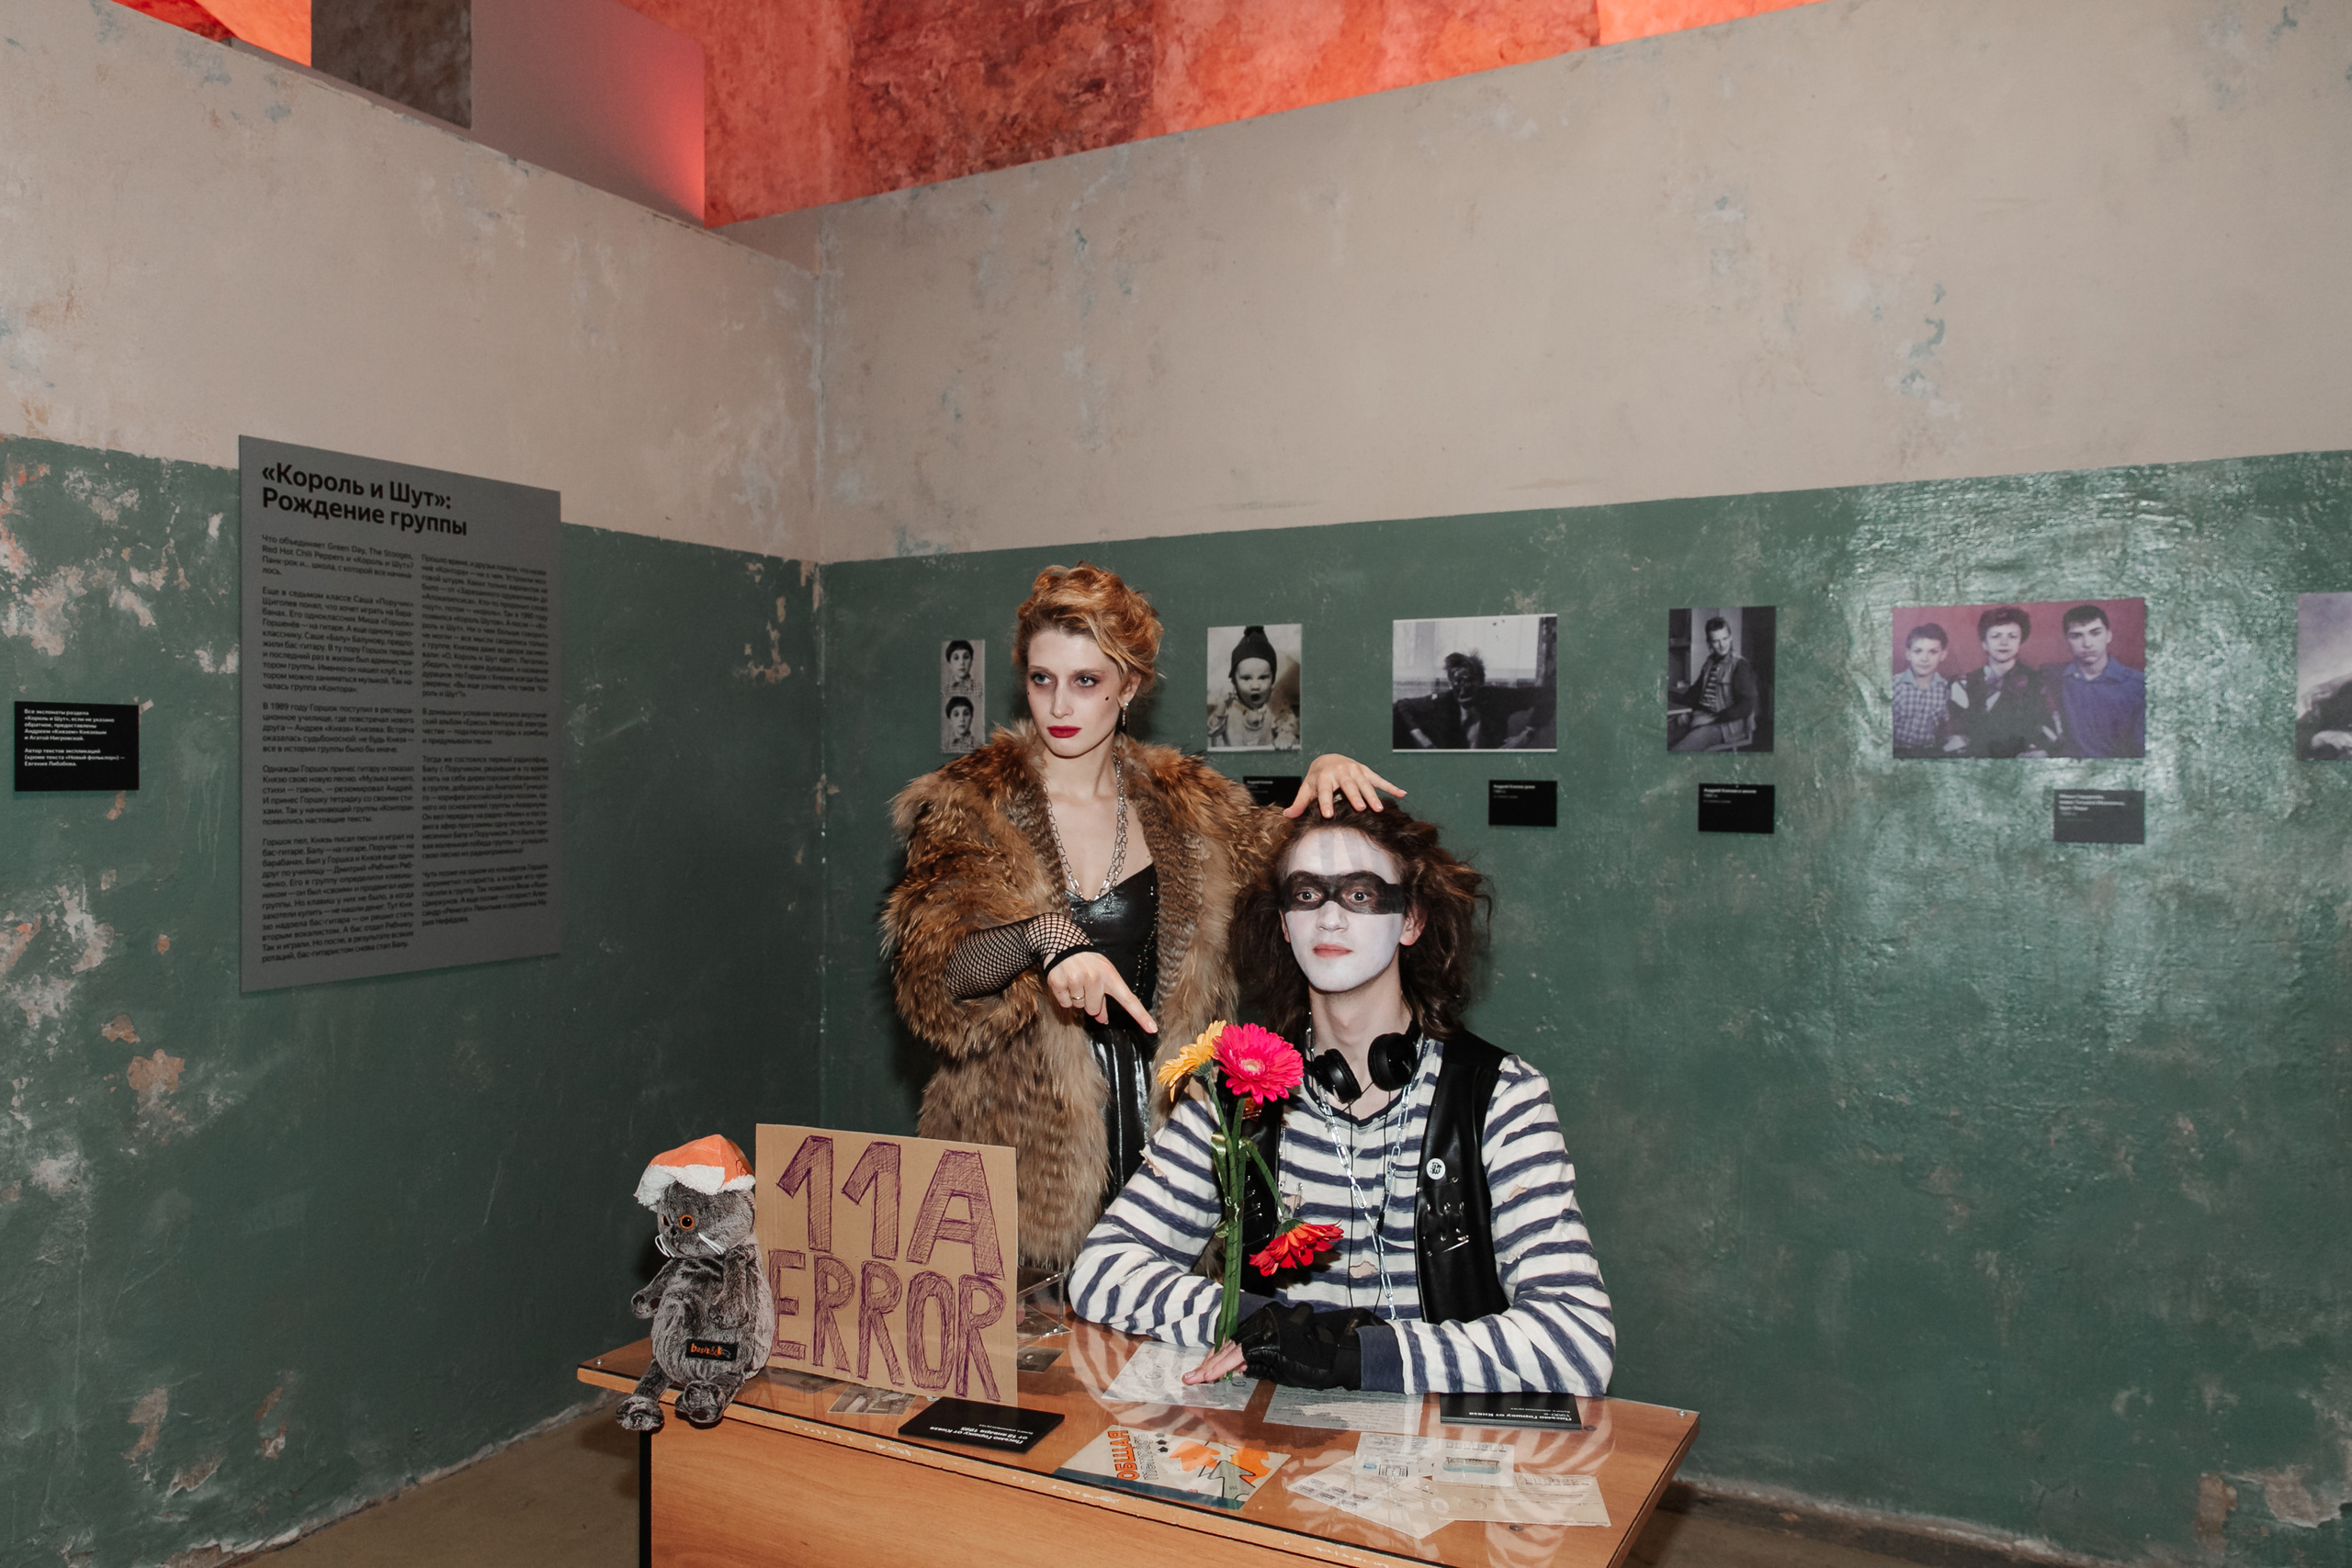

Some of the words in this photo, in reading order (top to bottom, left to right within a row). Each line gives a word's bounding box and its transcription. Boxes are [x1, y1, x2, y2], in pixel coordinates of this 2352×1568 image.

[262, 462, 364, 495] «Король
[370, 484, 383, 498] и
[390, 481, 451, 509] Шут»:
[263, 488, 384, 524] Рождение
[390, 510, 467, 536] группы
[768, 1248, 1007, 1403] ERROR
[929, 1426, 953, 1434] Князя
[963, 1430, 992, 1440] Горшку
[979, 1429, 1008, 1438] января
[993, 1436, 1023, 1444] Письмо
[1107, 1430, 1139, 1481] ОБЩАЯ
[1134, 1433, 1159, 1480] тетрадь
